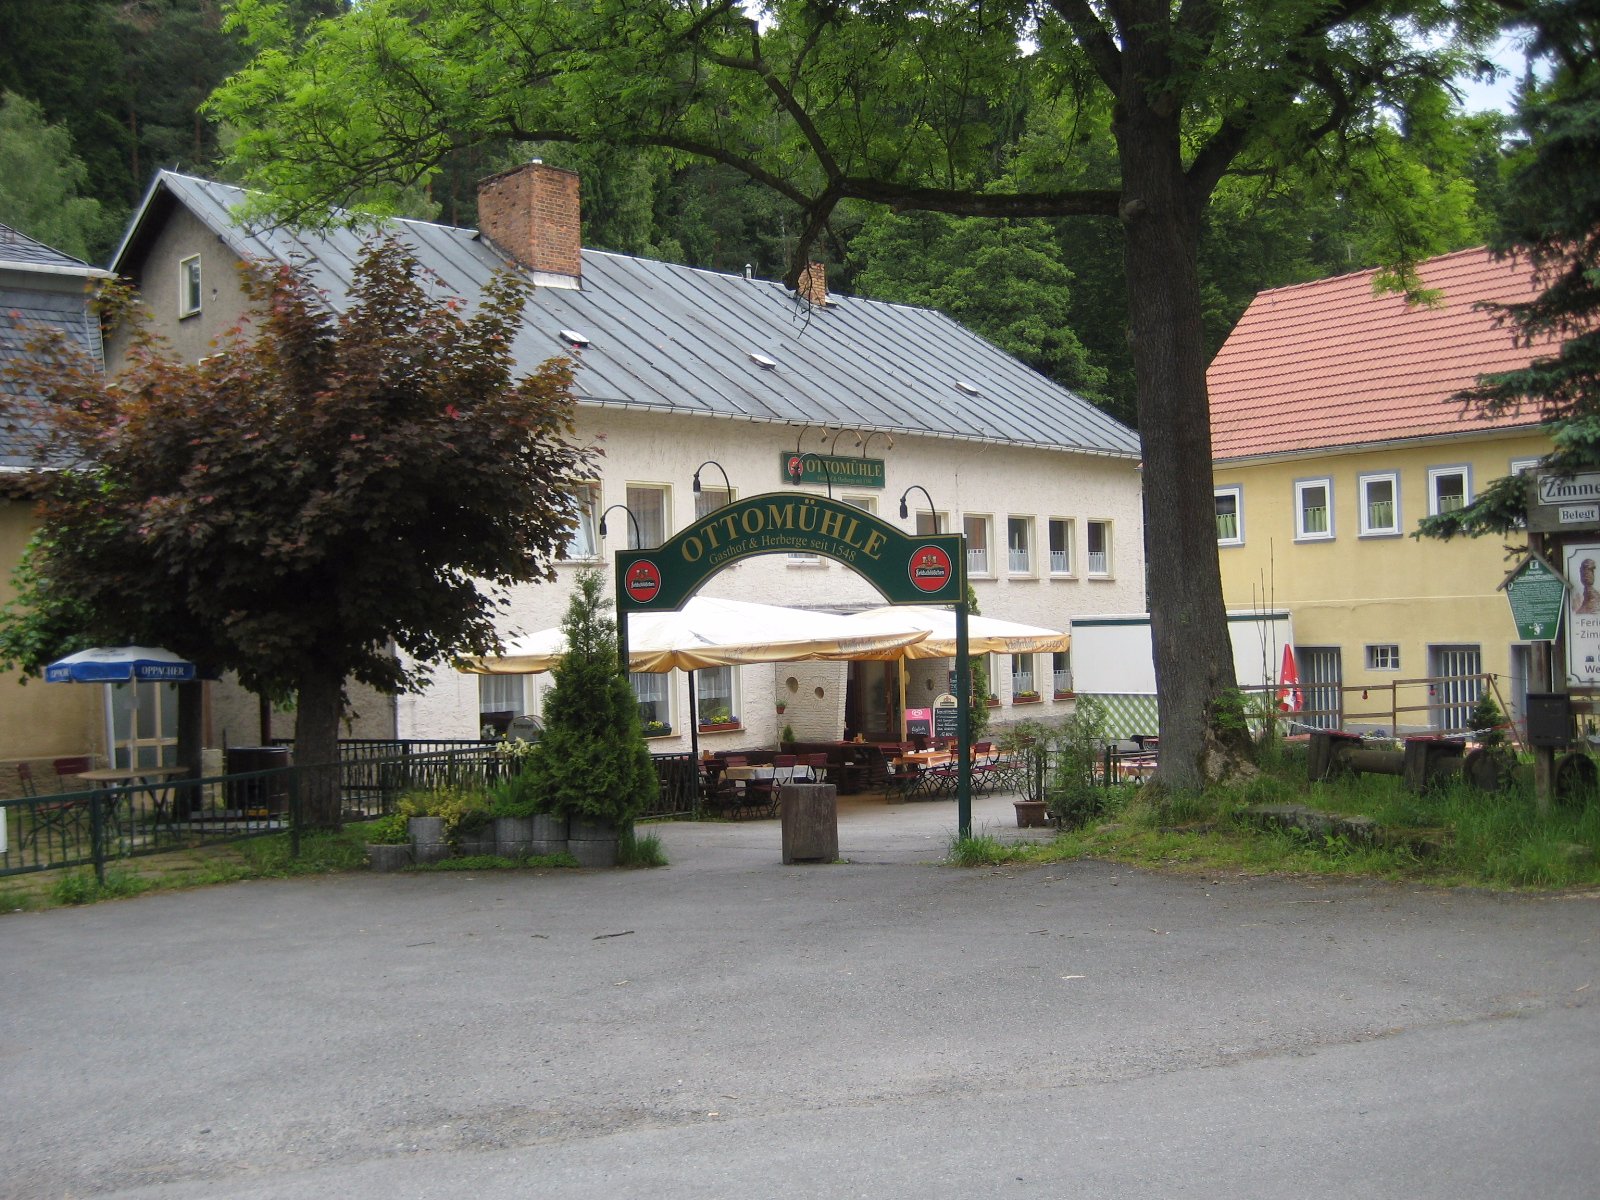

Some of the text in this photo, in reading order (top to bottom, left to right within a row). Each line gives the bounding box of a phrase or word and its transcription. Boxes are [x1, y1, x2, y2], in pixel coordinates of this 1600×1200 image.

[806, 459, 881, 477] OTTOMÜHLE
[1562, 510, 1595, 520] Belegt
[681, 499, 888, 563] OTTOMÜHLE
[709, 535, 857, 565] Gasthof & Herberge seit 1548
[141, 666, 184, 676] OPPACHER
